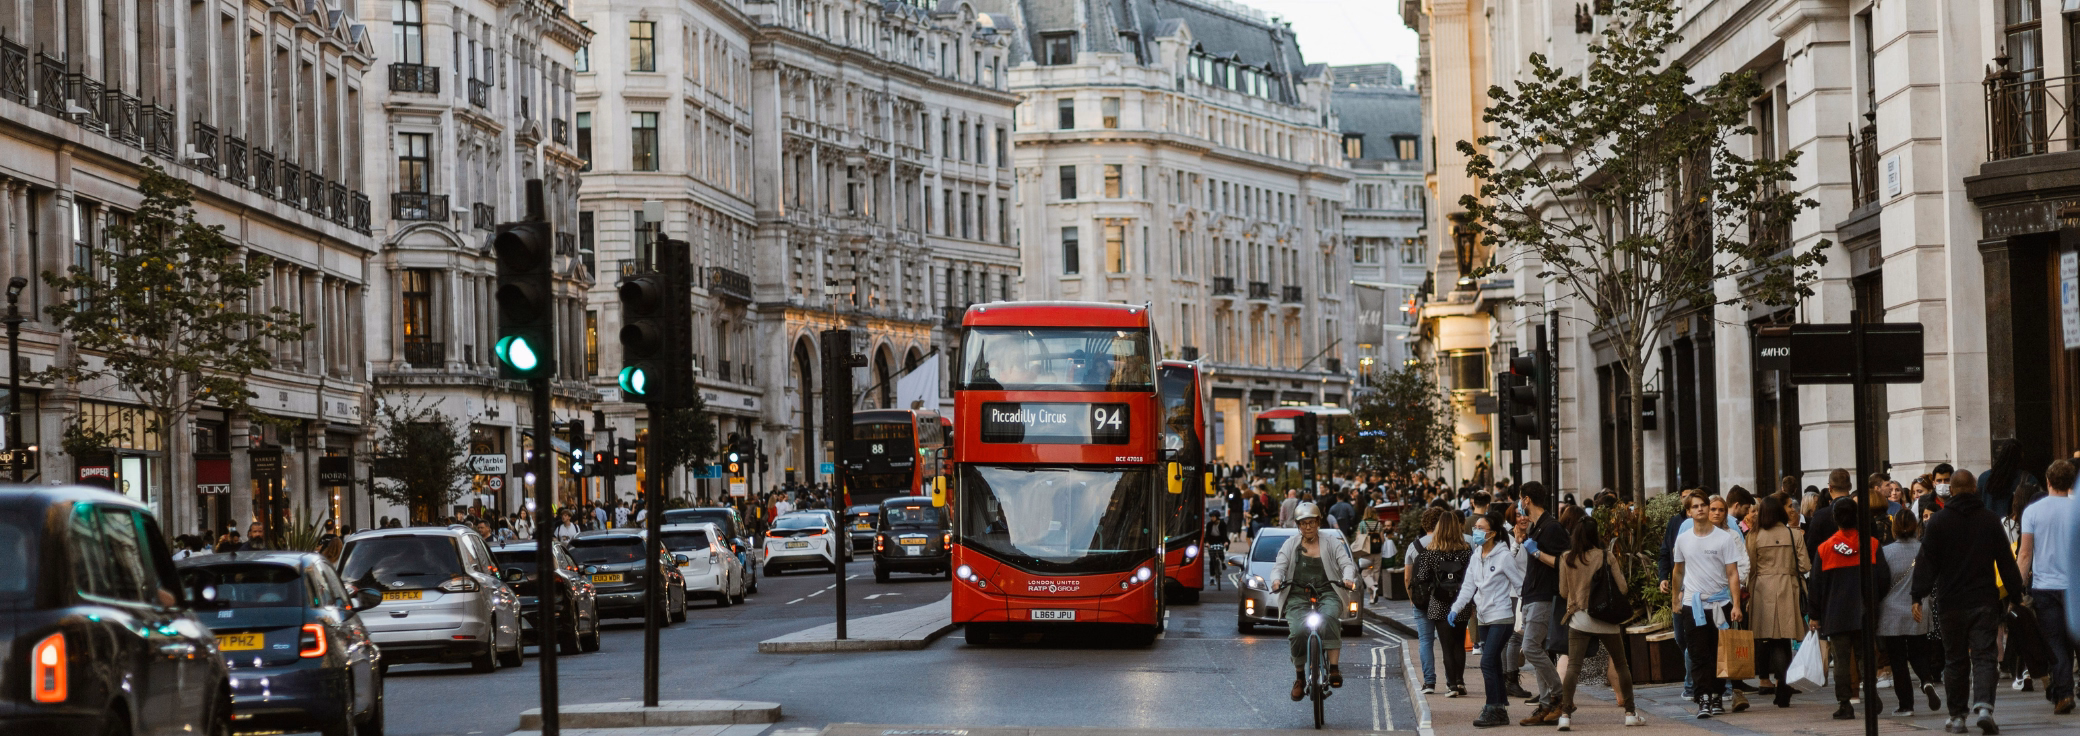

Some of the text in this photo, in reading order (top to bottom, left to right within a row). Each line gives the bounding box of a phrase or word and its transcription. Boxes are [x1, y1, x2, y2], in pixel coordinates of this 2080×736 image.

[992, 408, 1122, 430] Piccadilly Circus 94
[872, 444, 884, 454] 88
[81, 467, 109, 478] CAMPER
[198, 484, 230, 494] TUMI
[1834, 542, 1858, 556] JEA
[382, 591, 418, 600] T66 FLX
[230, 635, 255, 646] PHZ
[1736, 646, 1748, 659] H&M
